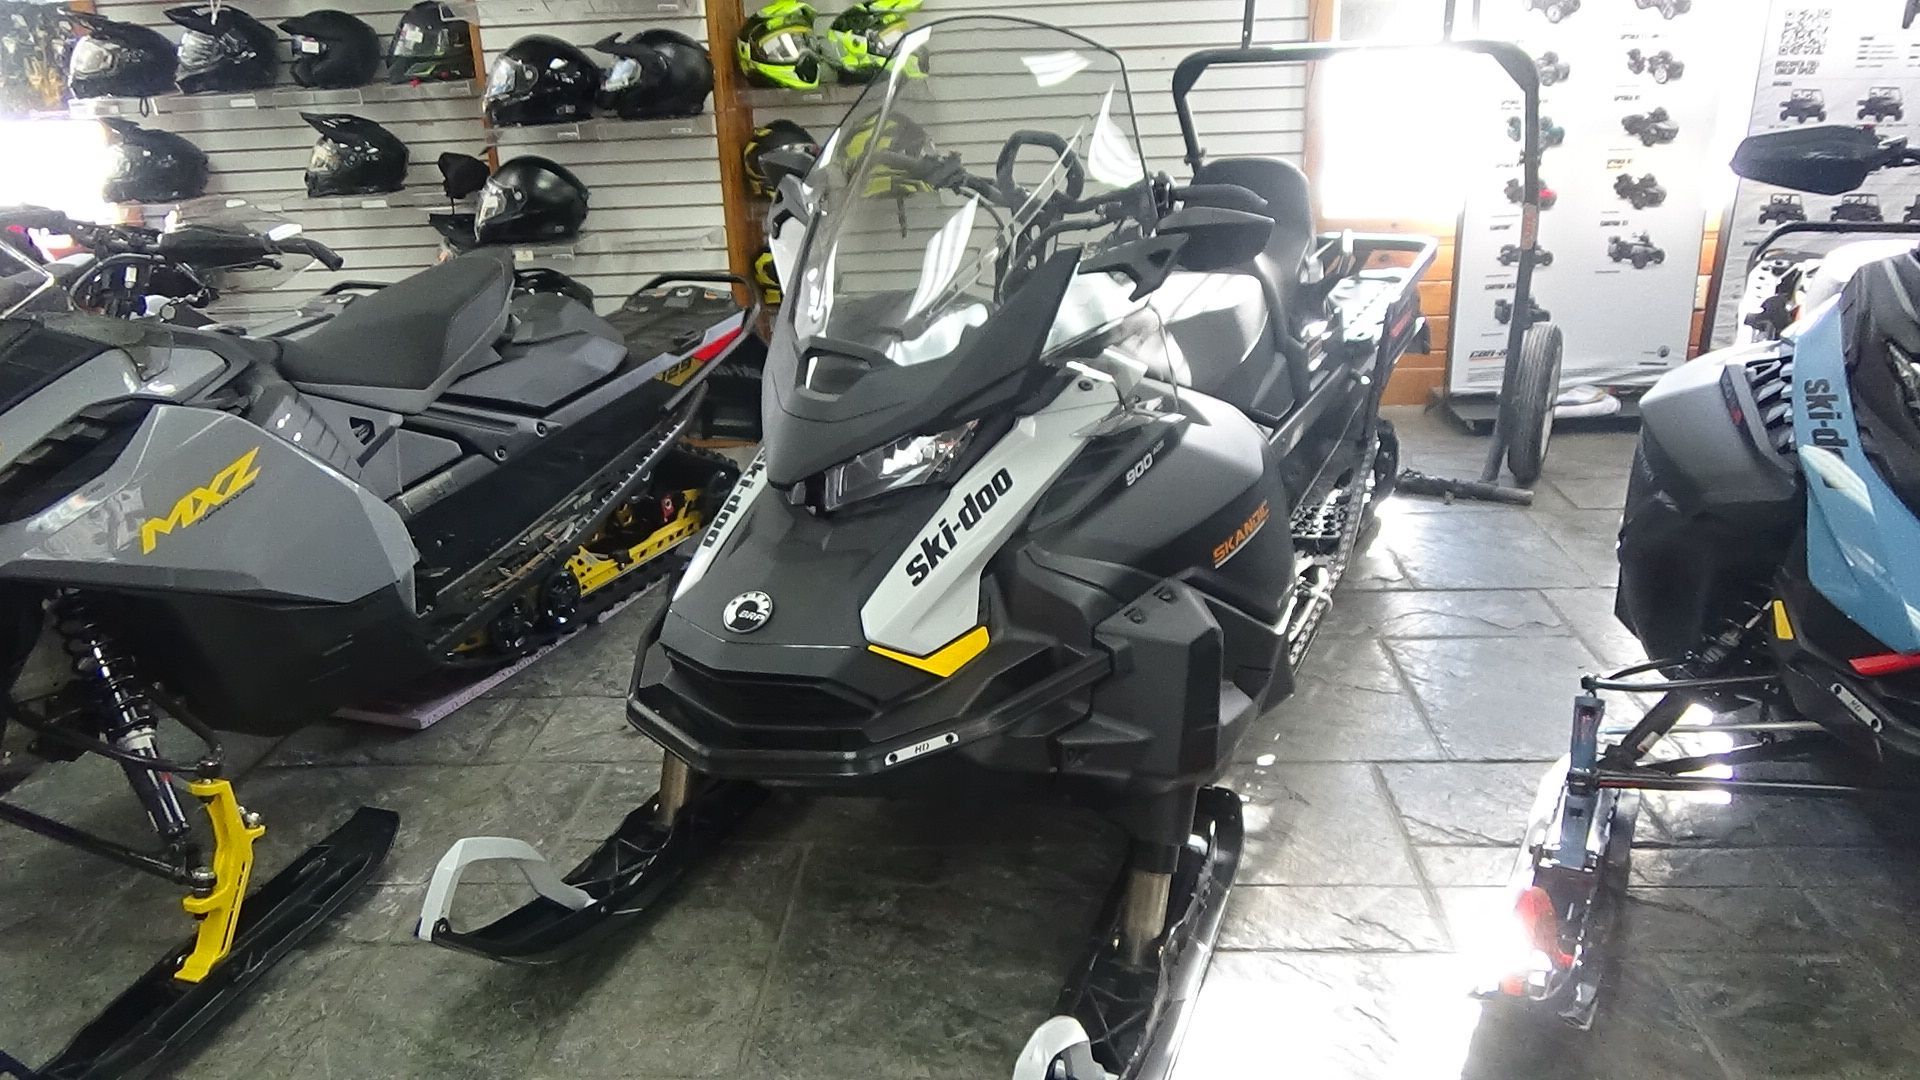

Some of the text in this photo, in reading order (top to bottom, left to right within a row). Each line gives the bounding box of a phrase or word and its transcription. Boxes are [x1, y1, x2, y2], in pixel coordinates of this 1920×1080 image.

[1126, 453, 1154, 486] 900
[142, 447, 262, 555] MXZ
[905, 467, 1013, 587] ski-doo
[738, 609, 766, 621] BRP
[915, 742, 930, 754] HD
